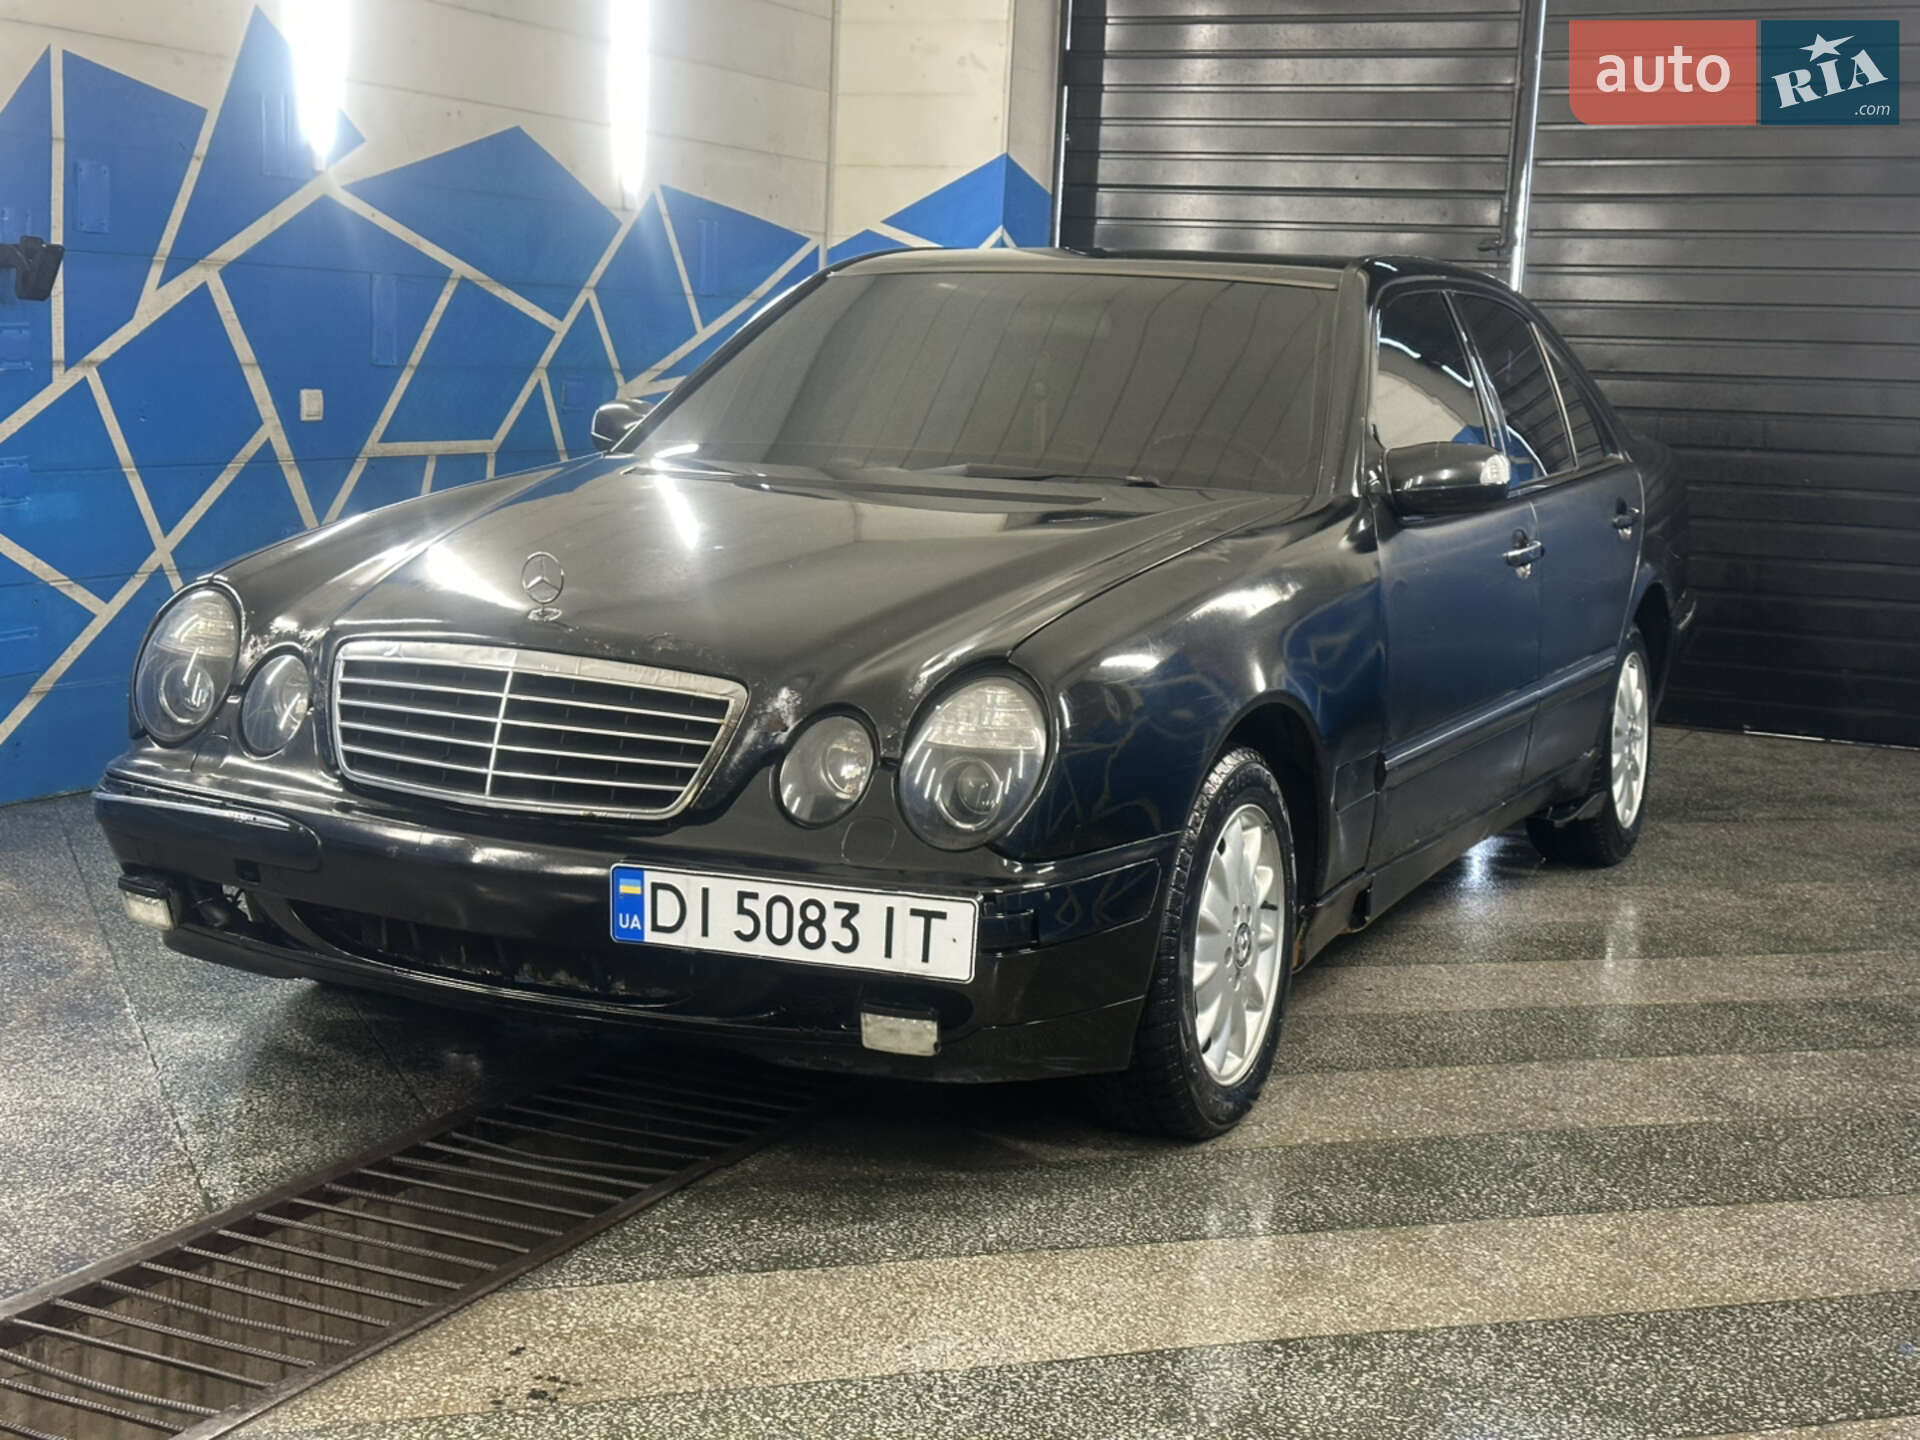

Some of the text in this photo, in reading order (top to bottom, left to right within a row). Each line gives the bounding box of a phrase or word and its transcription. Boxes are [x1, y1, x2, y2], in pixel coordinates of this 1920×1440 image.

[619, 912, 642, 930] UA
[649, 882, 948, 963] DI 5083 IT
